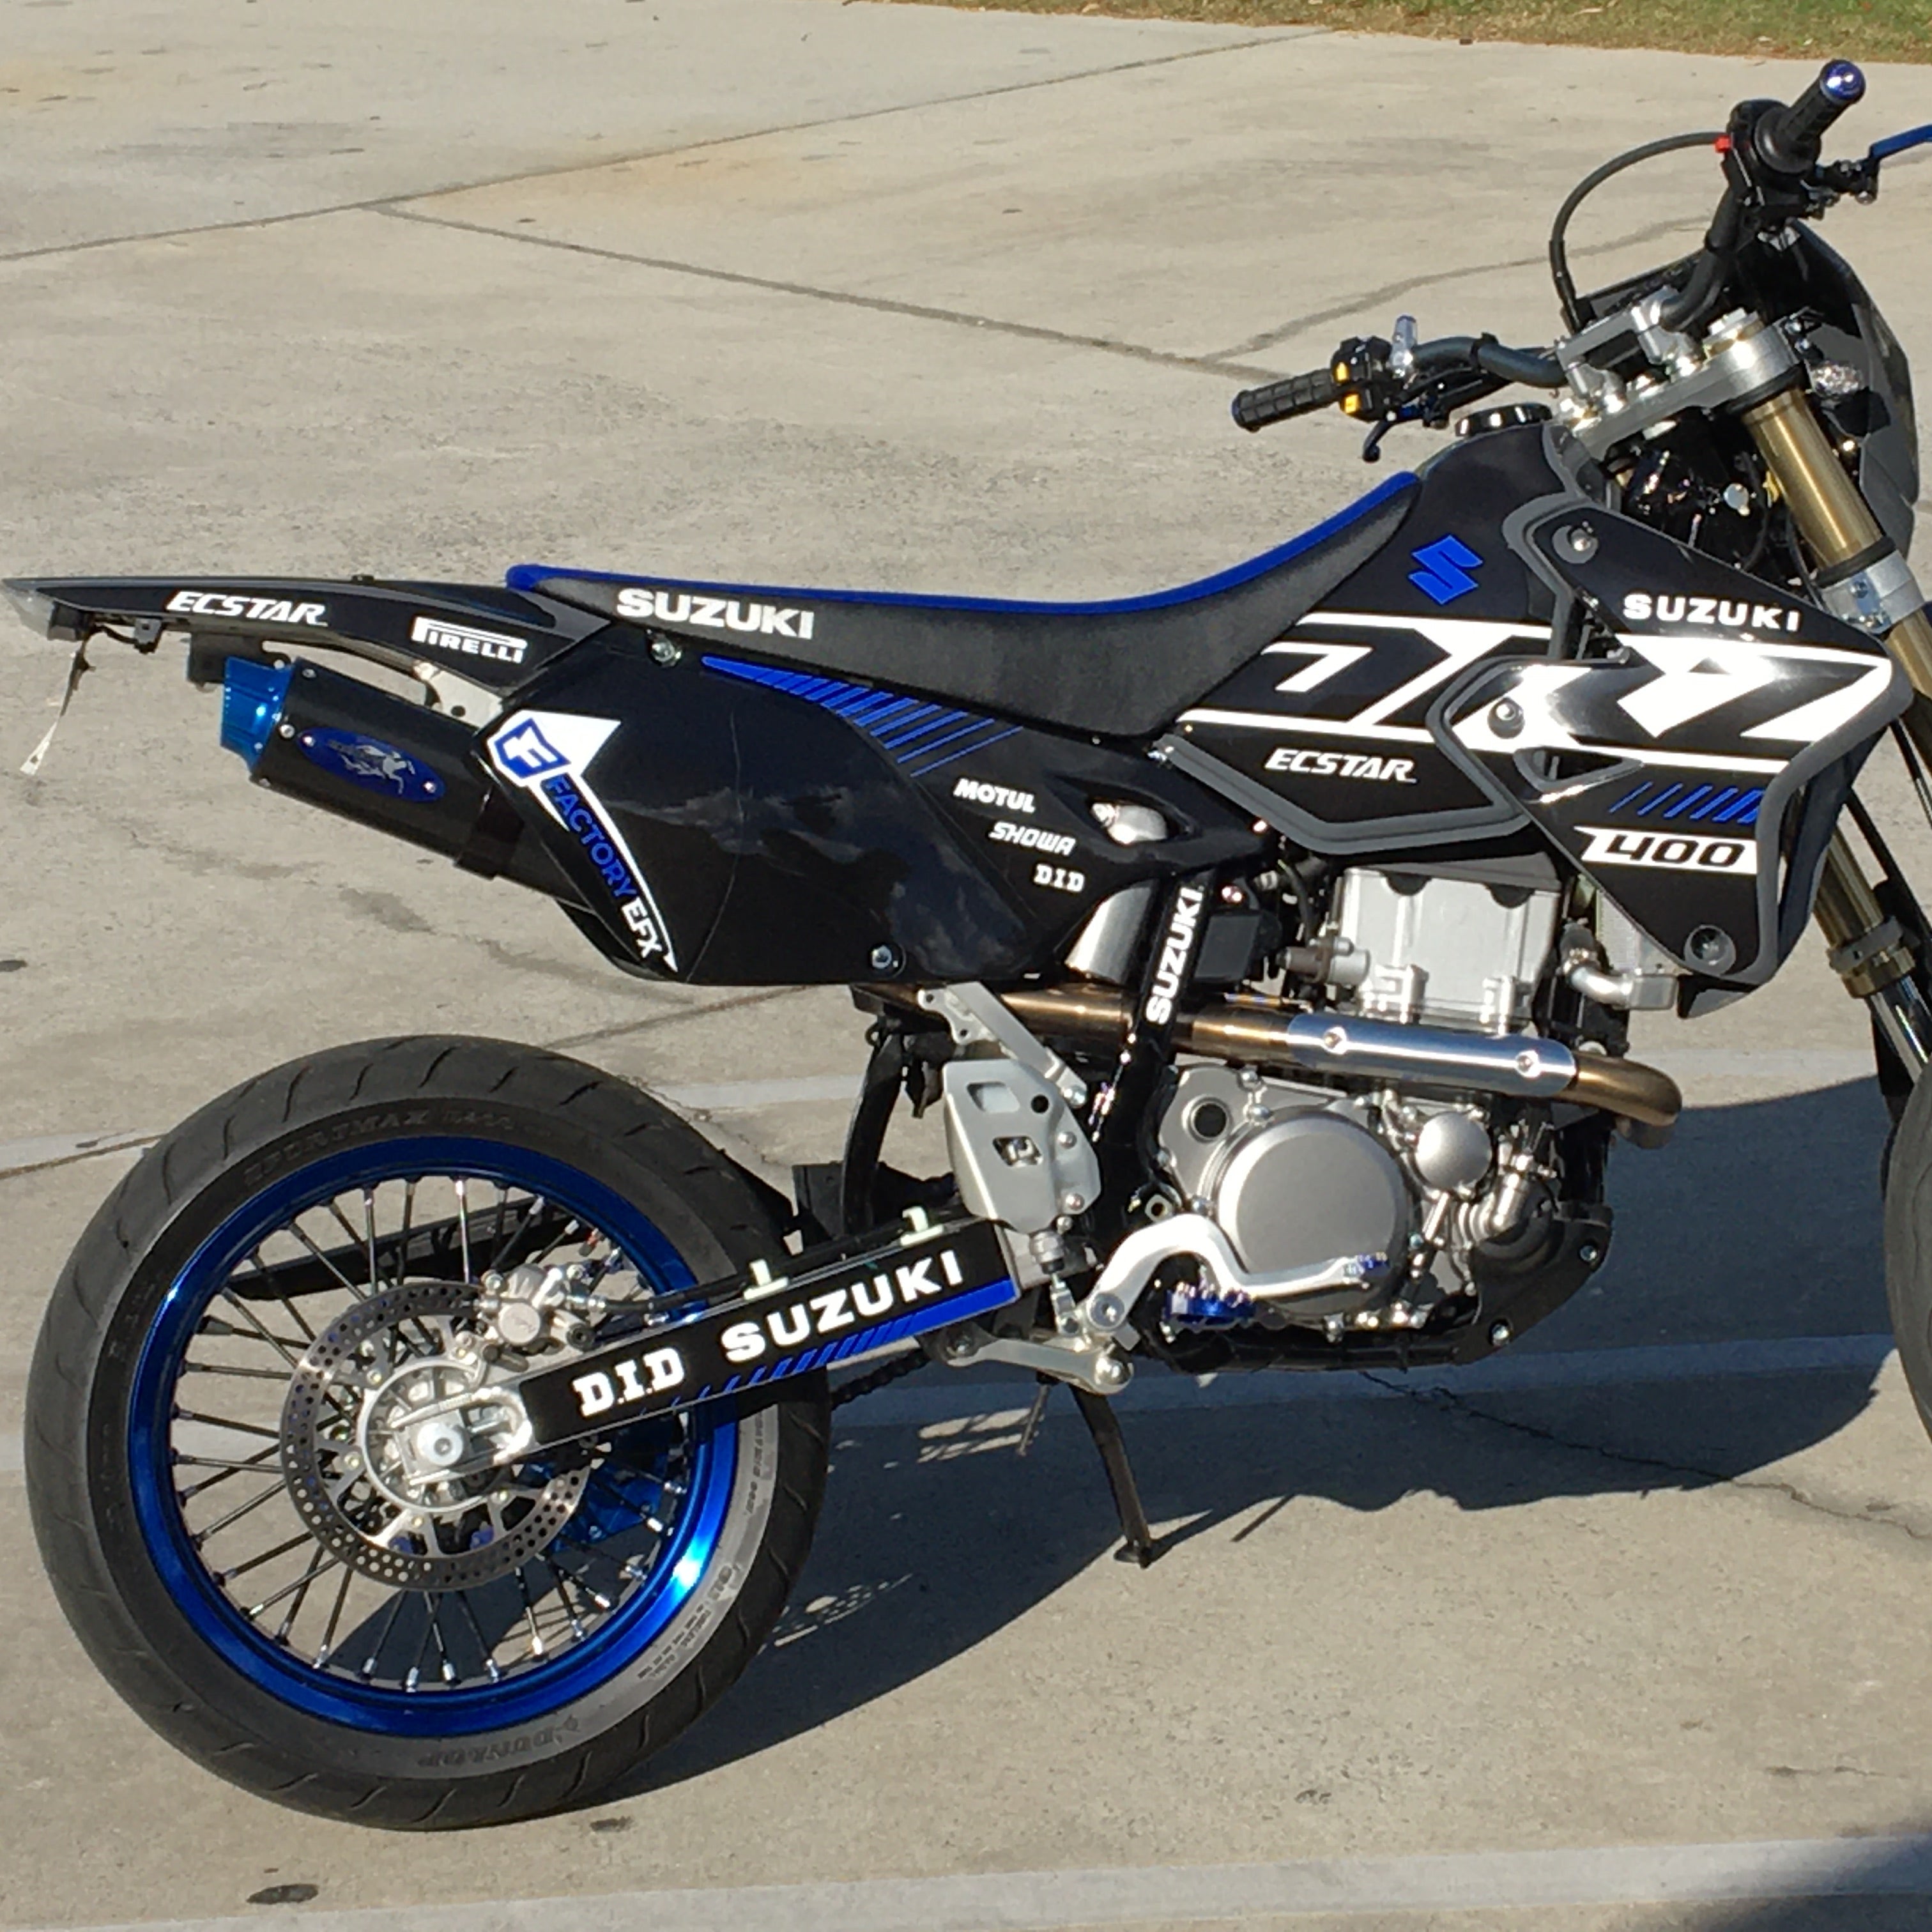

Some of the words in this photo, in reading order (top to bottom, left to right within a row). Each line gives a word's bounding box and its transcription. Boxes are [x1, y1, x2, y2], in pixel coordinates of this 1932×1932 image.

[166, 591, 328, 627] ECSTAR
[617, 588, 815, 640] SUZUKI
[1623, 594, 1799, 632] SUZUKI
[411, 617, 528, 664] PIRELLI
[1265, 748, 1417, 783] ECSTAR
[953, 778, 1036, 813] MOTUL
[988, 822, 1076, 855] SHOWA
[1606, 834, 1745, 868] 400
[546, 774, 638, 897] FACTORY
[621, 896, 663, 958] EFX
[1146, 887, 1204, 1024] SUZUKI
[721, 1250, 963, 1362] SUZUKI
